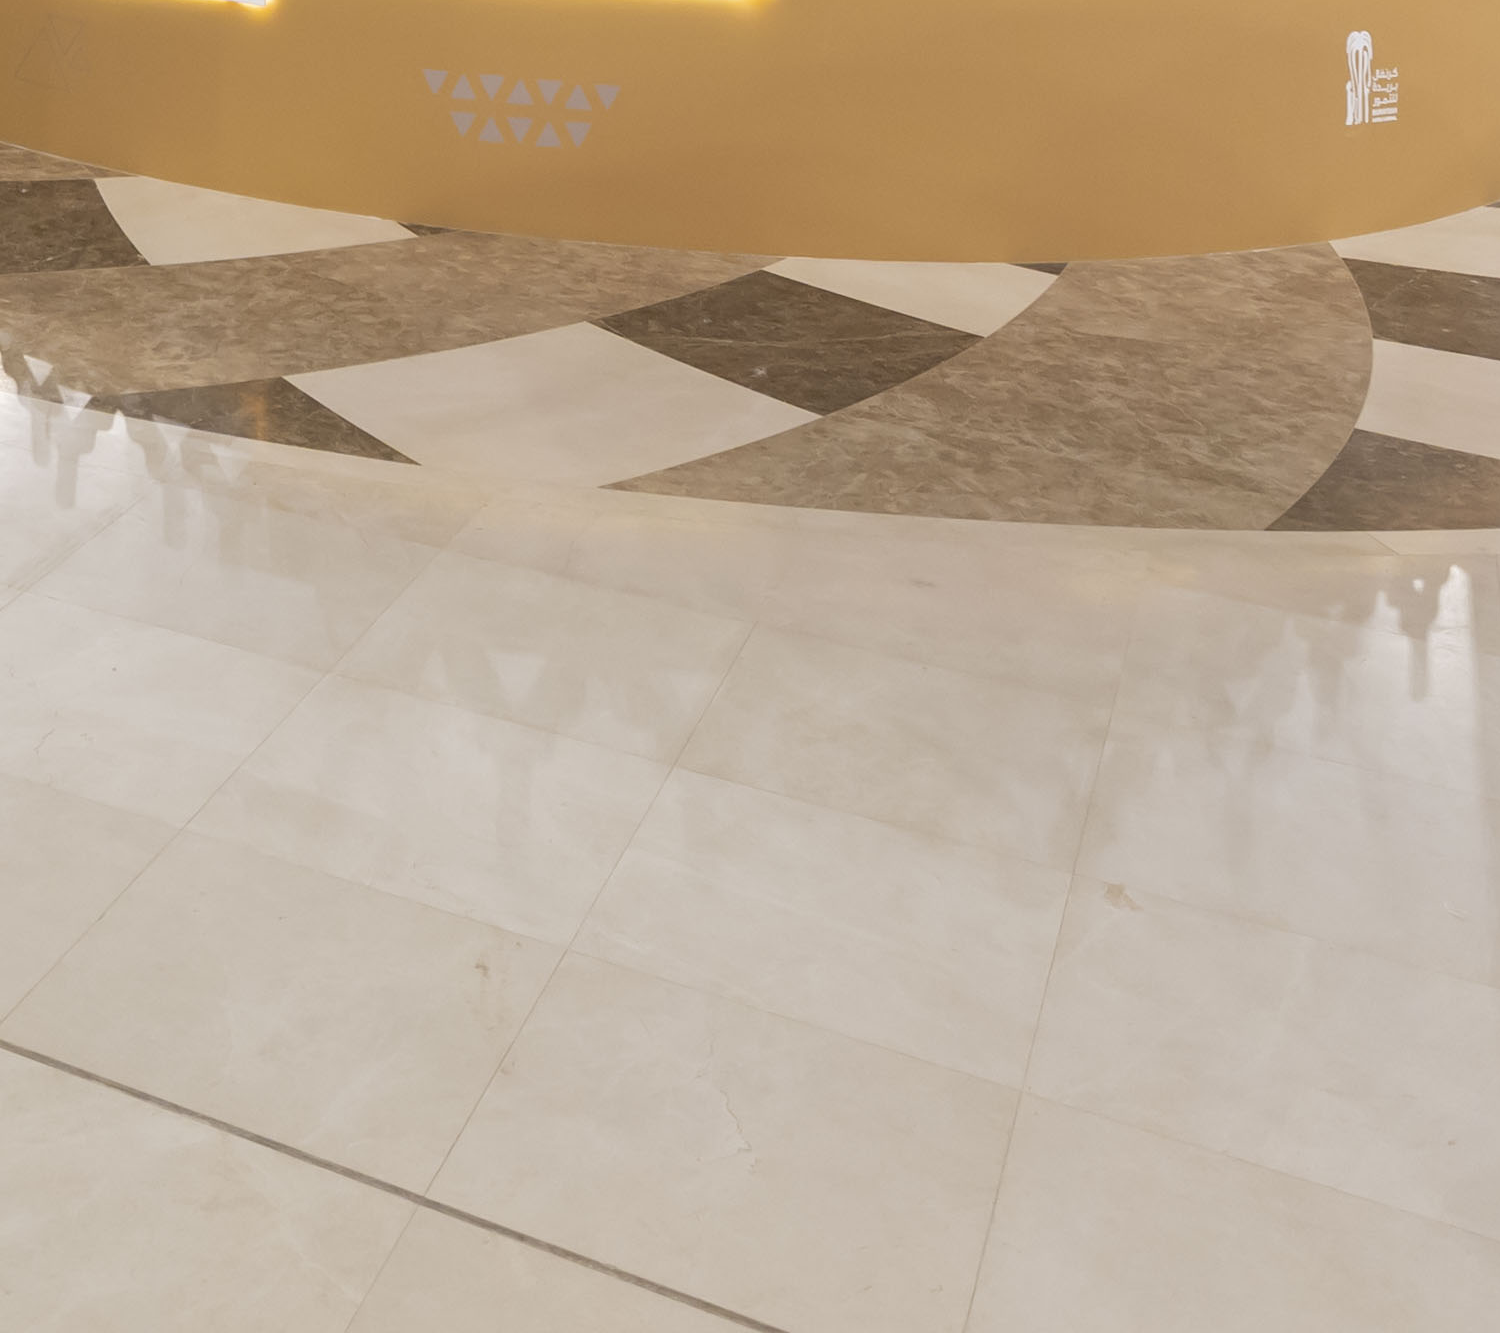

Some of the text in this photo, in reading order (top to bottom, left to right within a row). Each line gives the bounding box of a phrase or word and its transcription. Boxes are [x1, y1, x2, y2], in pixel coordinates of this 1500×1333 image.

[1372, 67, 1398, 81] كرنفال
[1372, 82, 1398, 93] بريدة
[1372, 93, 1398, 107] للتمور
